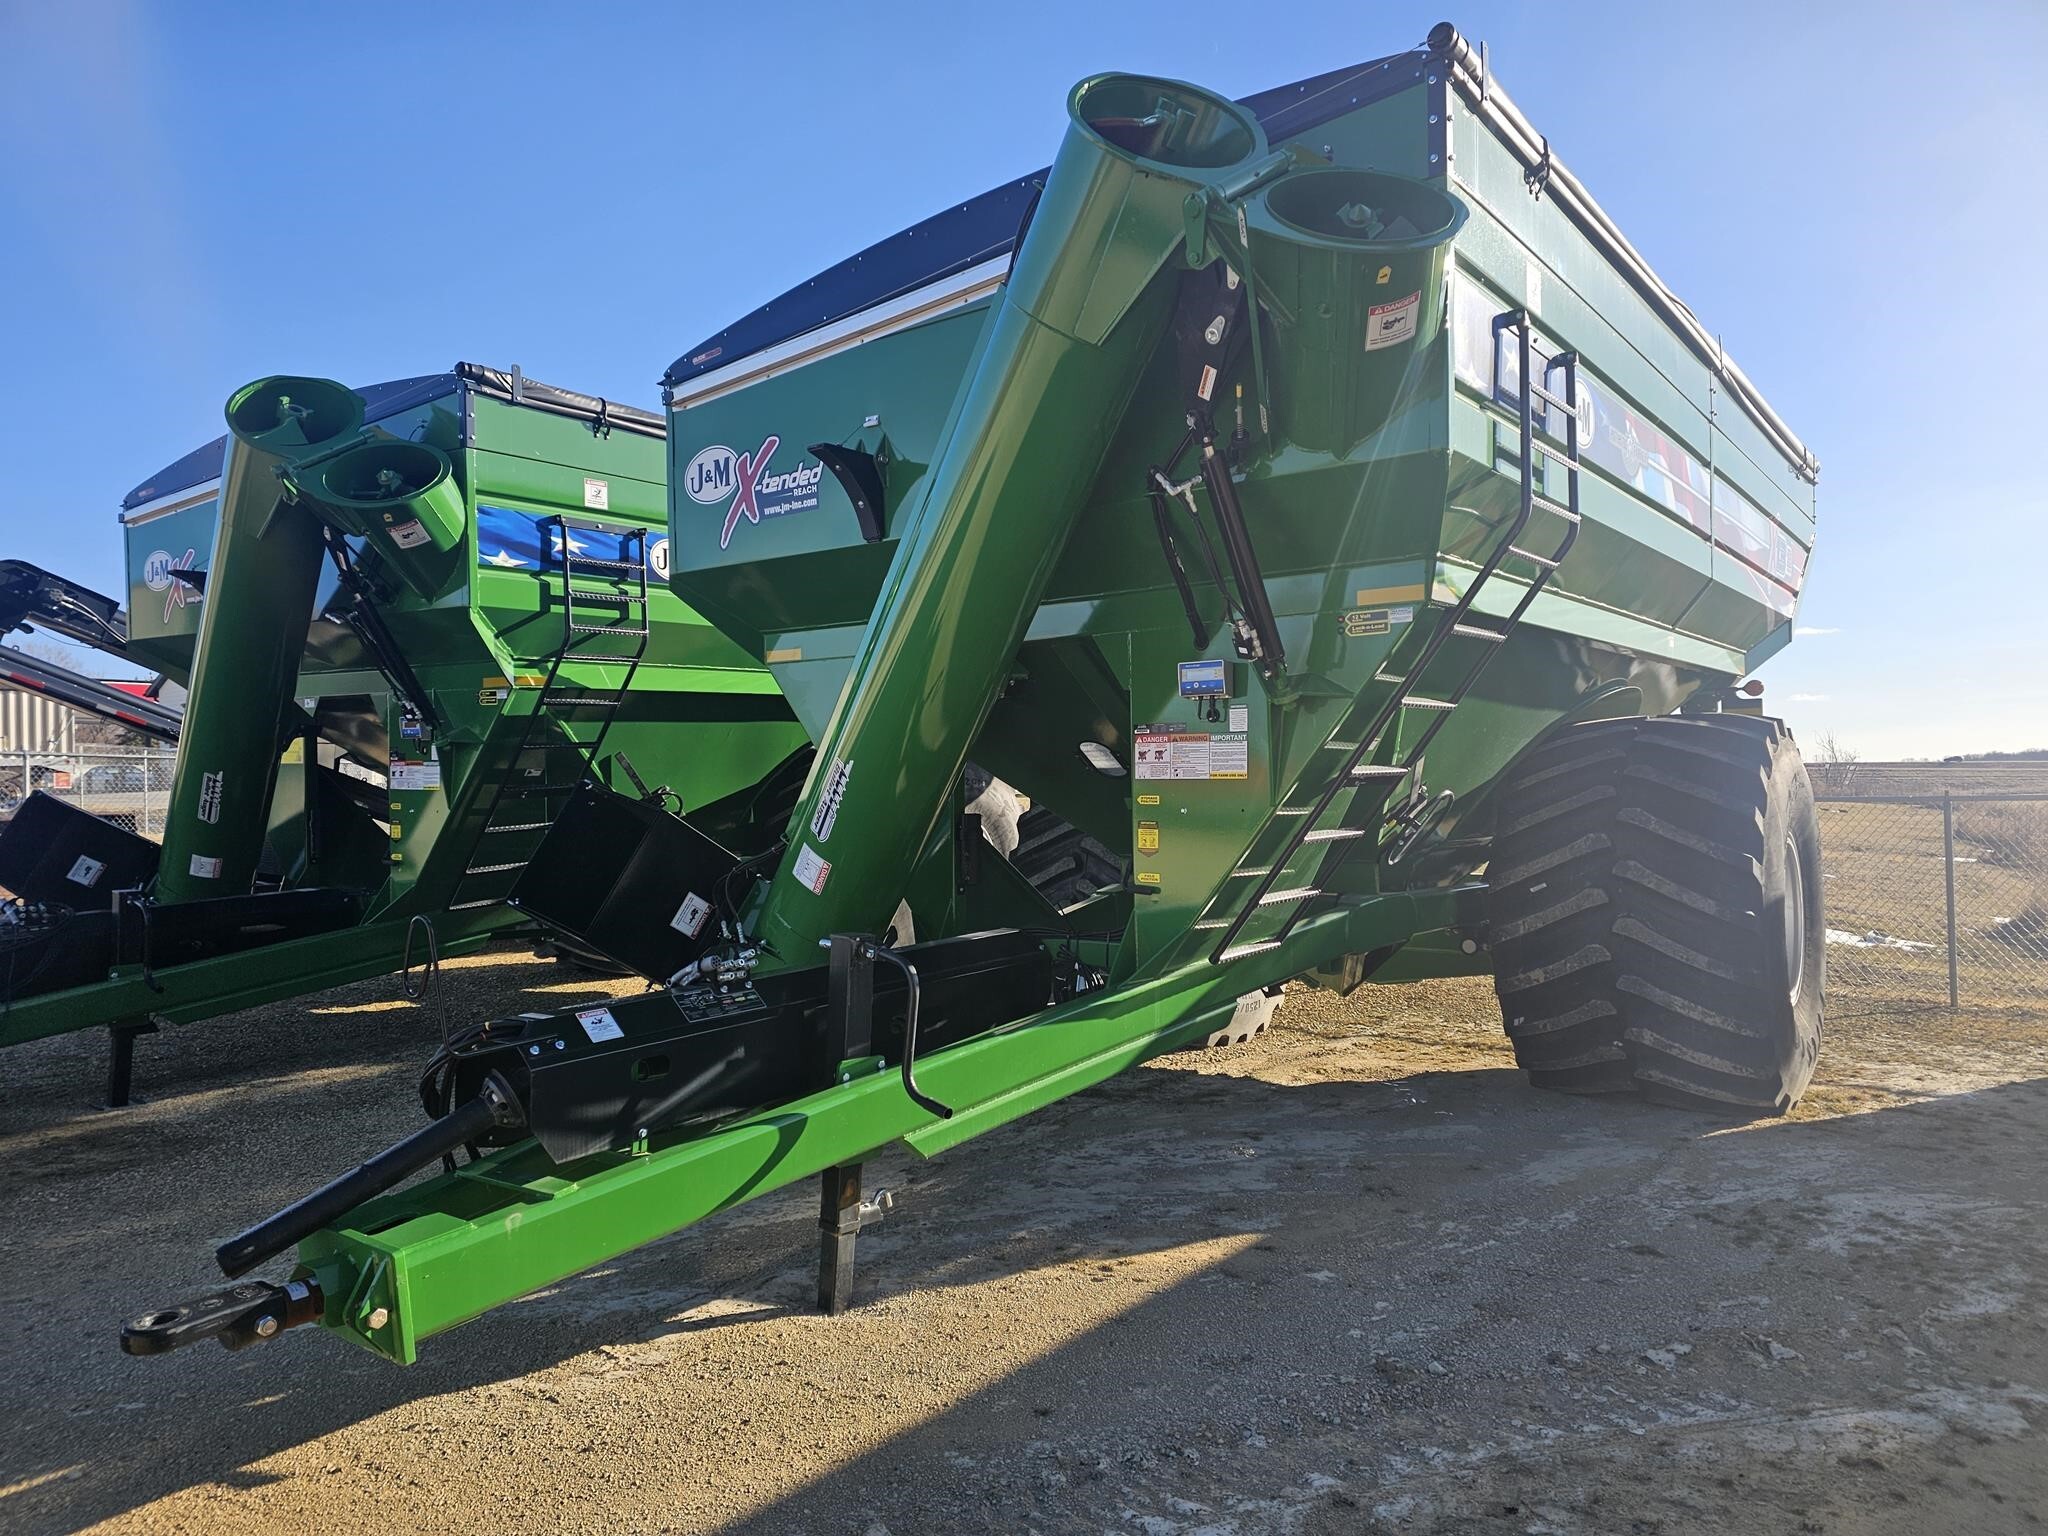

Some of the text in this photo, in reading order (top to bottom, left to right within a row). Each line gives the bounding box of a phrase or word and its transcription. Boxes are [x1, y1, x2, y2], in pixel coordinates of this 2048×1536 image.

[1384, 295, 1416, 312] DANGER
[690, 456, 731, 494] J&M
[793, 484, 818, 497] REACH
[764, 498, 818, 515] www.jm-inc.com
[146, 558, 169, 583] J&M
[814, 763, 841, 830] Bullet Auger
[814, 868, 828, 895] DANGER
